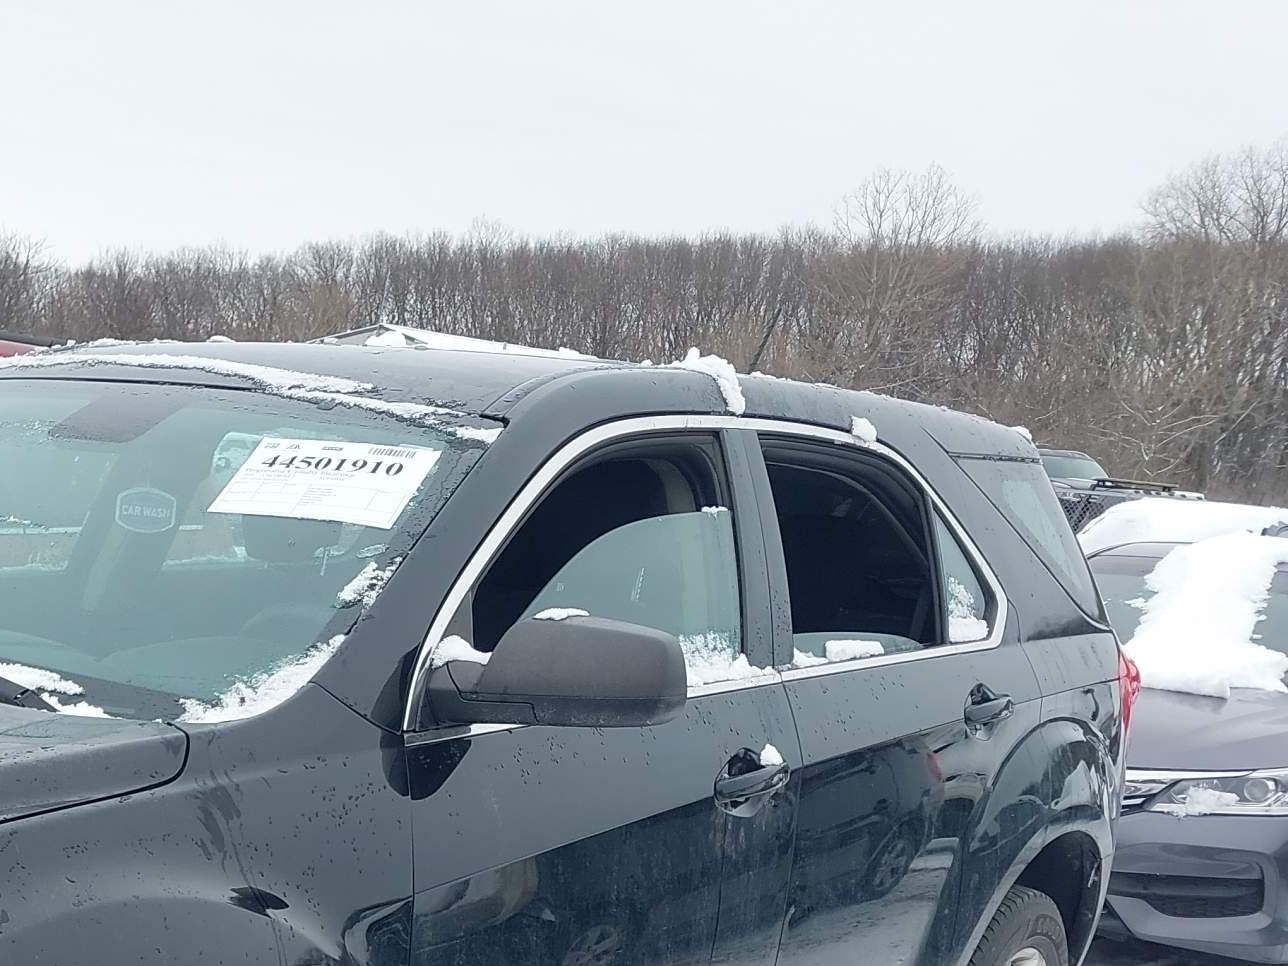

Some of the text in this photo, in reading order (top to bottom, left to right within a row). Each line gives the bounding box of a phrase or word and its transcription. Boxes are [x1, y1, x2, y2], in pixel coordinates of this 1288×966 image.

[261, 454, 404, 477] 44501910
[121, 504, 171, 519] CAR WASH
